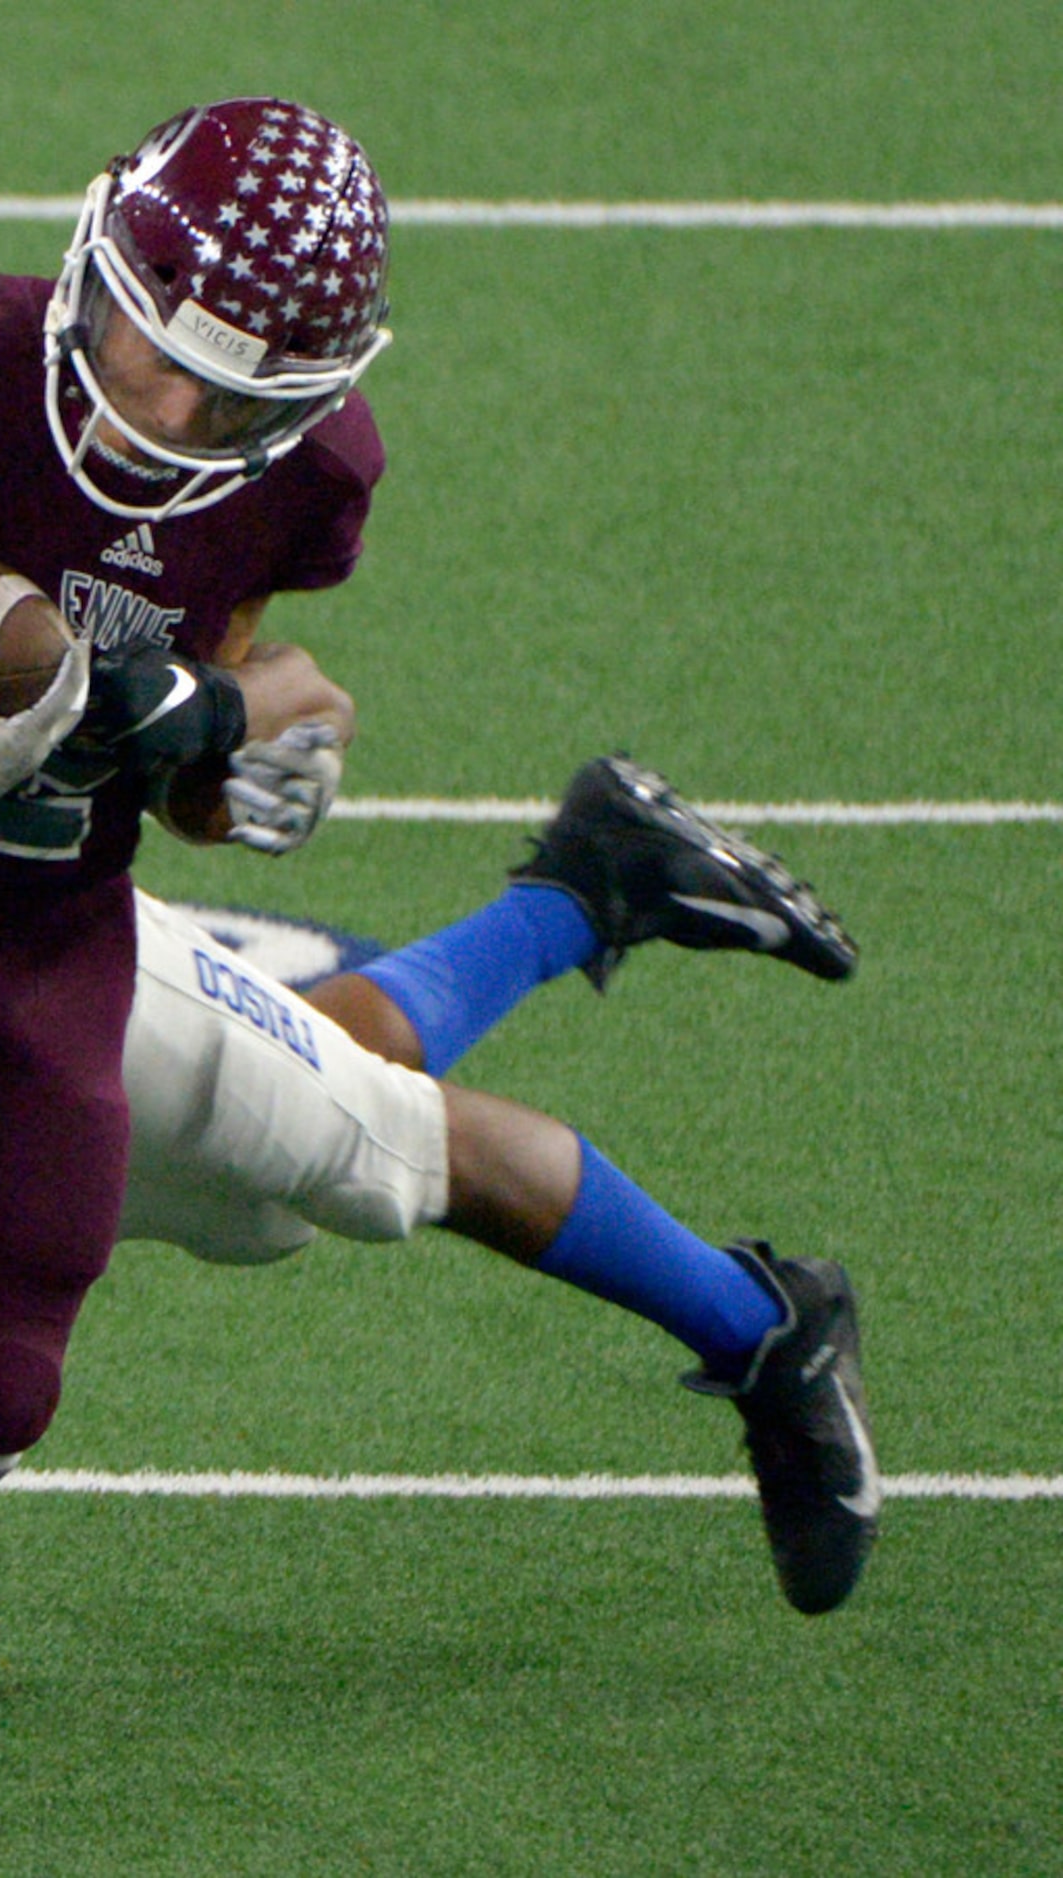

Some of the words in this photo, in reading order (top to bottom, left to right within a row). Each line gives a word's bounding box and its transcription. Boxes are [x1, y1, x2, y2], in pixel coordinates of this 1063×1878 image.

[195, 315, 249, 356] VICIS
[100, 548, 164, 577] adidas
[192, 948, 322, 1073] FRISCO
